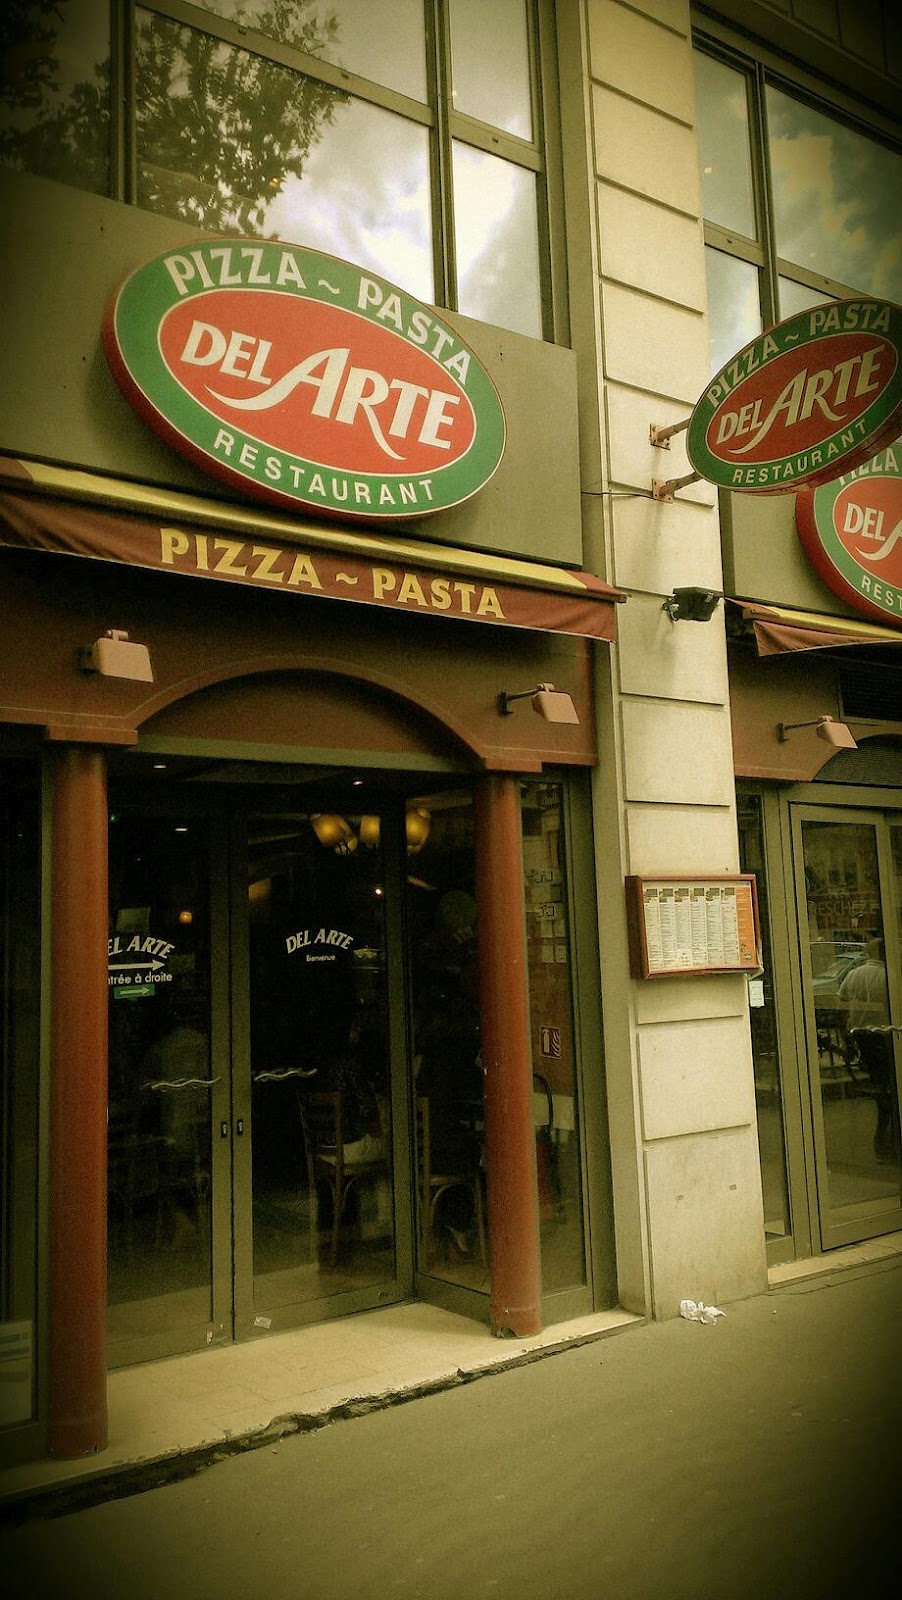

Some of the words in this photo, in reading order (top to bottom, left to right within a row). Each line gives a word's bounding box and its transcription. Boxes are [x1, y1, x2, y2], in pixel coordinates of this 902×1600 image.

[163, 247, 306, 295] PIZZA
[357, 276, 472, 385] PASTA
[180, 320, 272, 385] DEL
[706, 335, 780, 408] PIZZA
[810, 303, 890, 336] PASTA
[203, 347, 461, 460] ARTE
[716, 399, 763, 445] DEL
[727, 344, 886, 454] ARTE
[213, 428, 433, 505] RESTAURANT
[732, 418, 866, 484] RESTAURANT
[843, 502, 886, 541] DEL
[160, 527, 324, 590] PIZZA
[372, 567, 507, 619] PASTA
[126, 935, 176, 959] ARTE
[286, 930, 311, 954] DEL
[313, 928, 354, 949] ARTE
[306, 954, 336, 962] Bienvenue
[134, 973, 142, 983] à
[145, 971, 173, 983] droite
